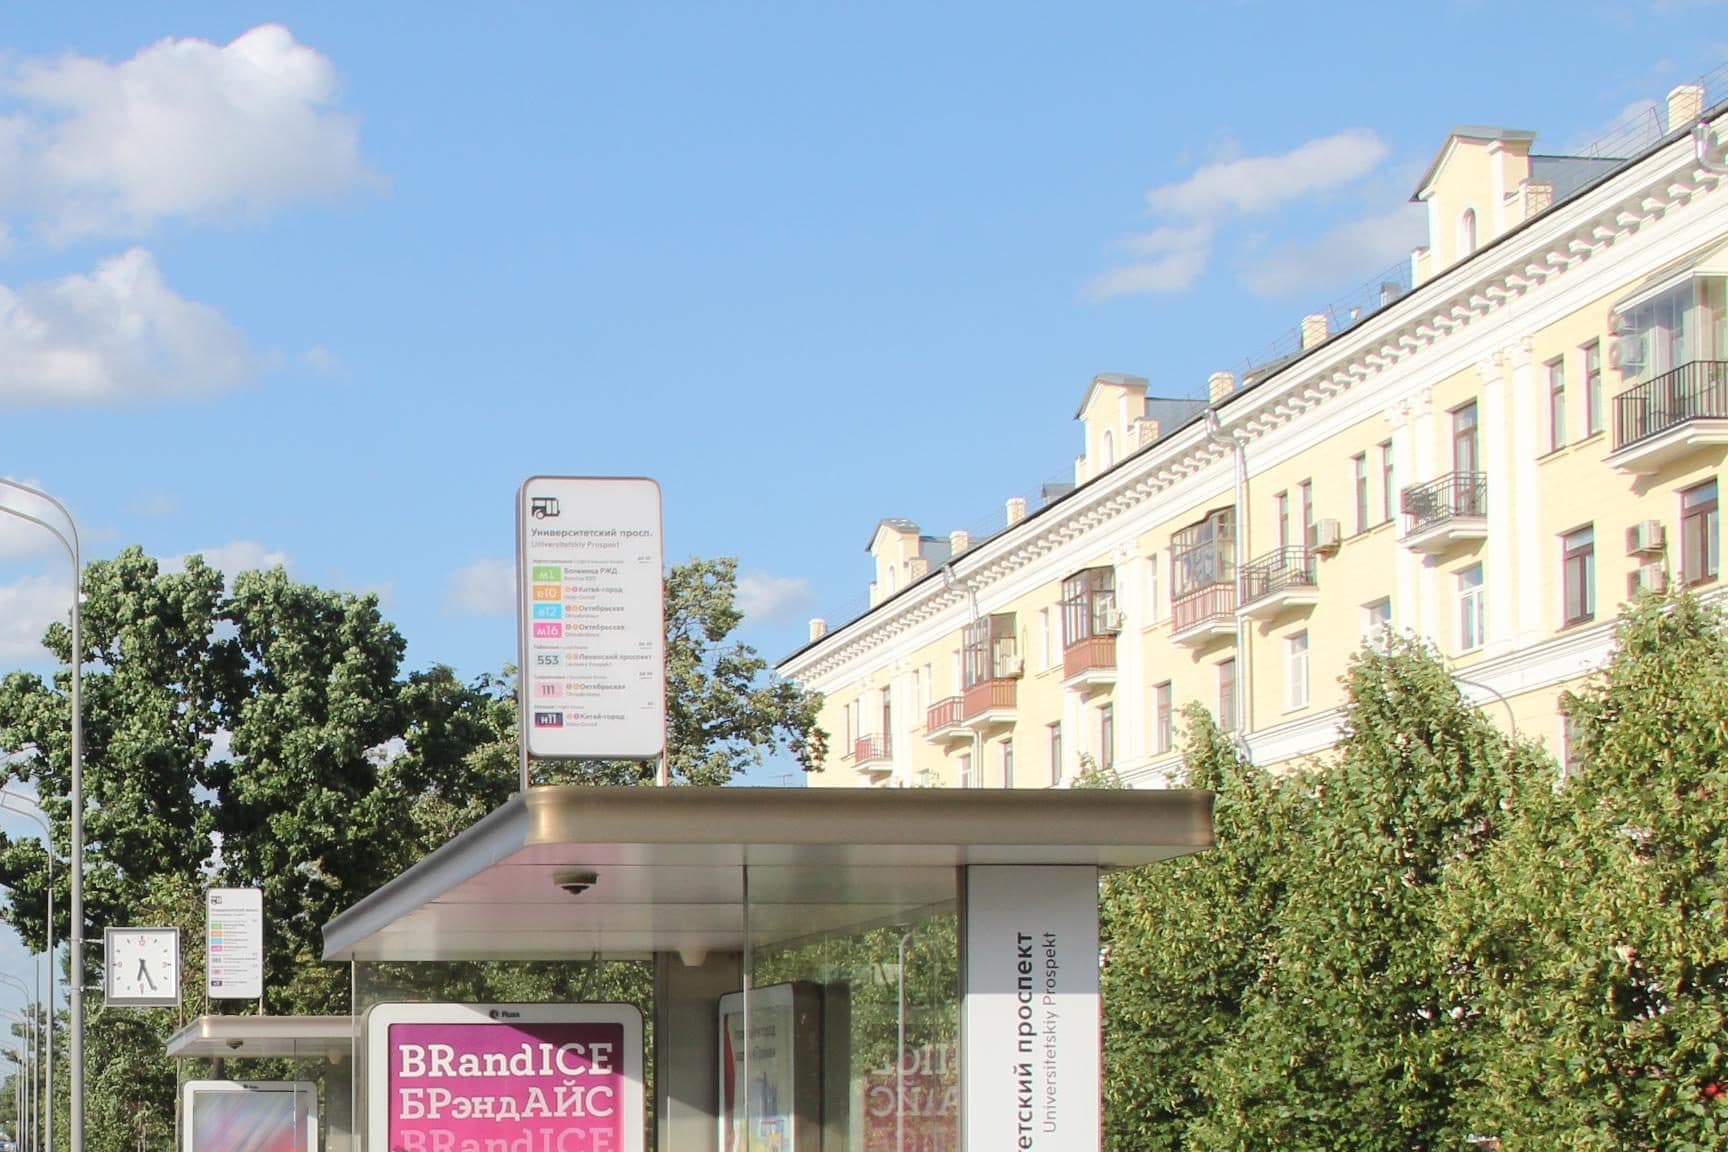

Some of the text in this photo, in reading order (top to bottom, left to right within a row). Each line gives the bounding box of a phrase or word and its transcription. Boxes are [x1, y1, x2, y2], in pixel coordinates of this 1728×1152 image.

[531, 528, 653, 538] Университетский просп.
[537, 655, 559, 665] 553
[542, 685, 555, 695] 111
[1017, 932, 1038, 1054] проспект
[1043, 932, 1061, 1133] Universitetskiy Prospekt
[398, 1042, 613, 1078] BRandICE
[398, 1079, 614, 1122] БРэндАЙС
